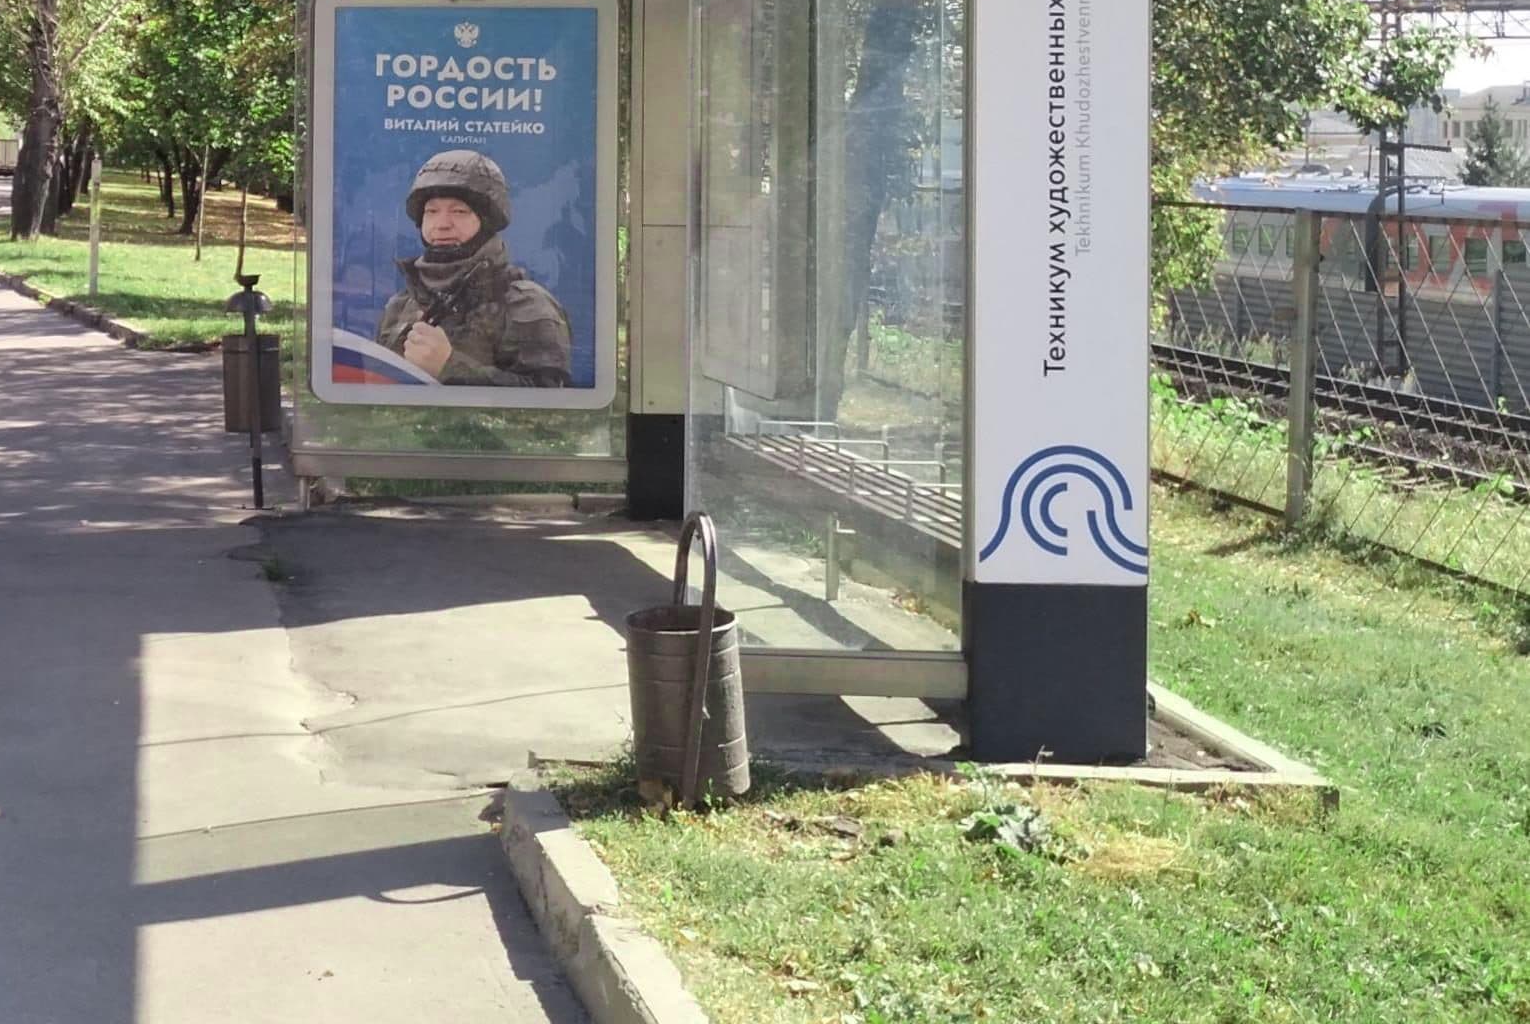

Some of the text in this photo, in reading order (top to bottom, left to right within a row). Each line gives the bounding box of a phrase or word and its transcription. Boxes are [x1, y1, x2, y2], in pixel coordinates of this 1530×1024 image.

[376, 53, 557, 81] ГОРДОСТЬ
[387, 84, 543, 112] РОССИИ!
[384, 117, 545, 135] ВИТАЛИЙ СТАТЕЙКО
[1075, 155, 1091, 256] Tekhnikum
[1043, 243, 1071, 377] Техникум
